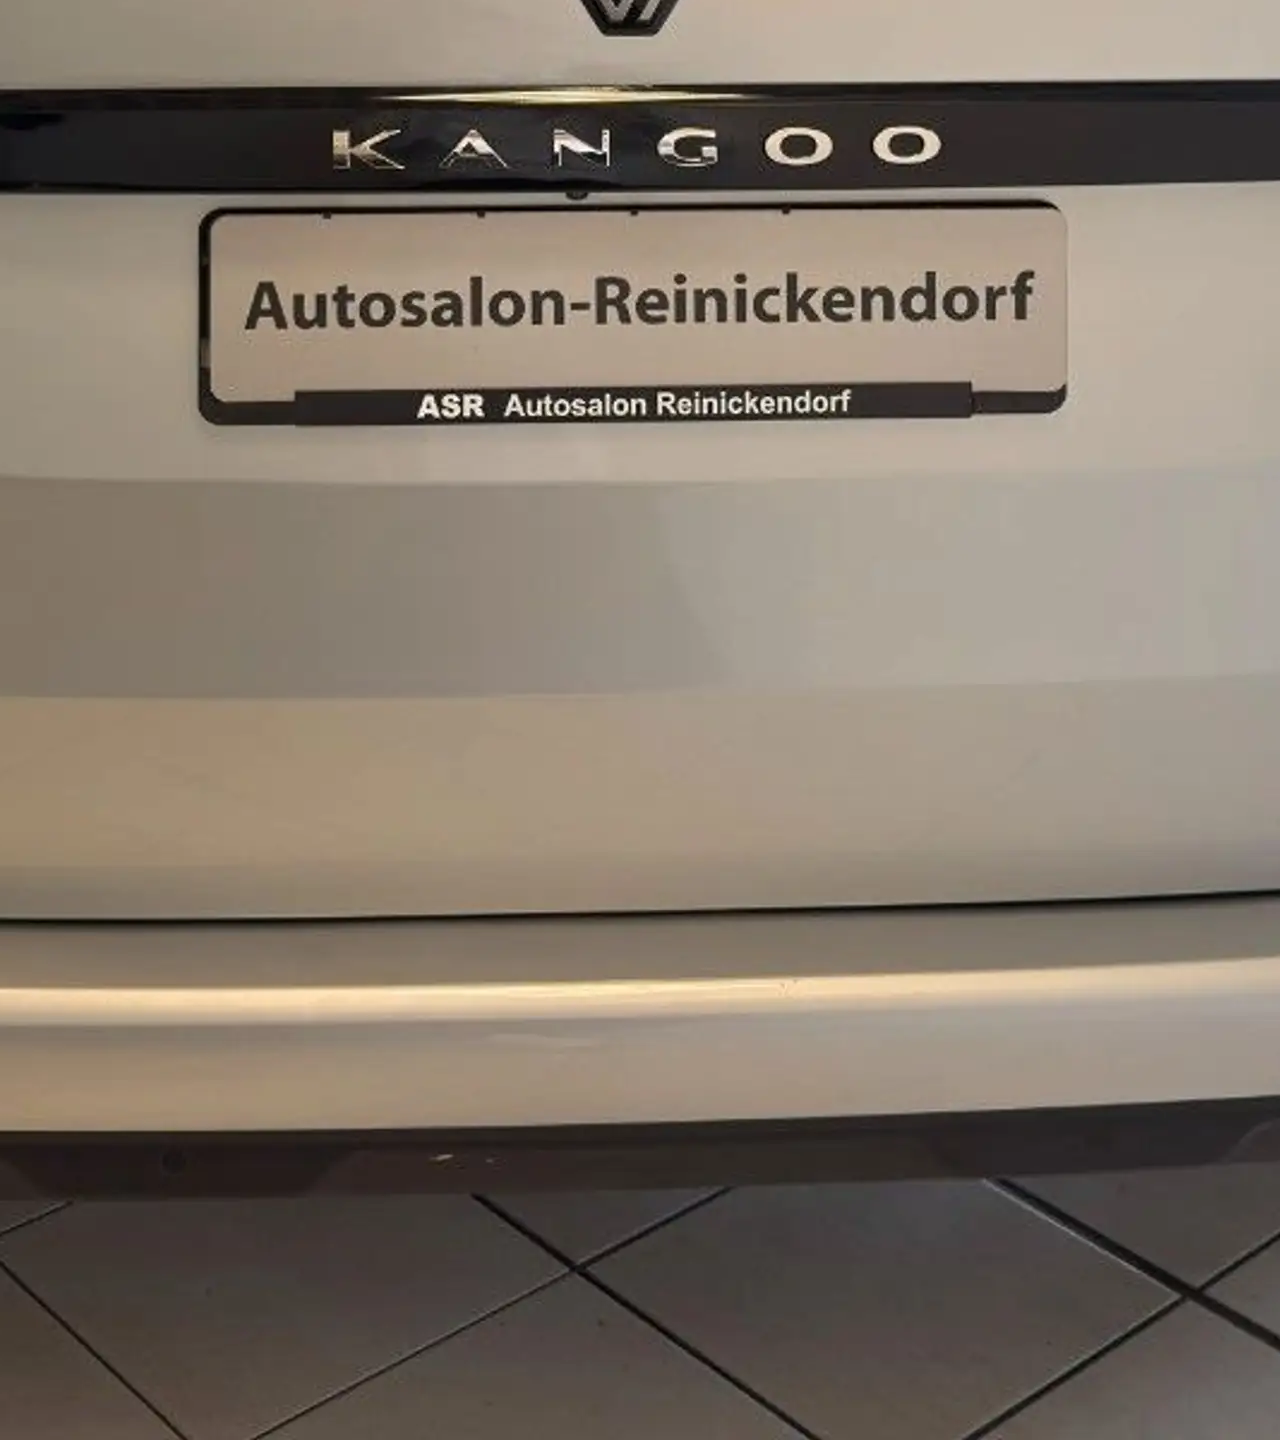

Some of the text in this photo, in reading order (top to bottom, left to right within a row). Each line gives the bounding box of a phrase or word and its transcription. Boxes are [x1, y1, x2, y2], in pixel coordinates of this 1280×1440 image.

[332, 125, 943, 170] KANGOO
[244, 270, 1035, 330] Autosalon-Reinickendorf
[417, 388, 851, 419] ASR Autosalon Reinickendorf
